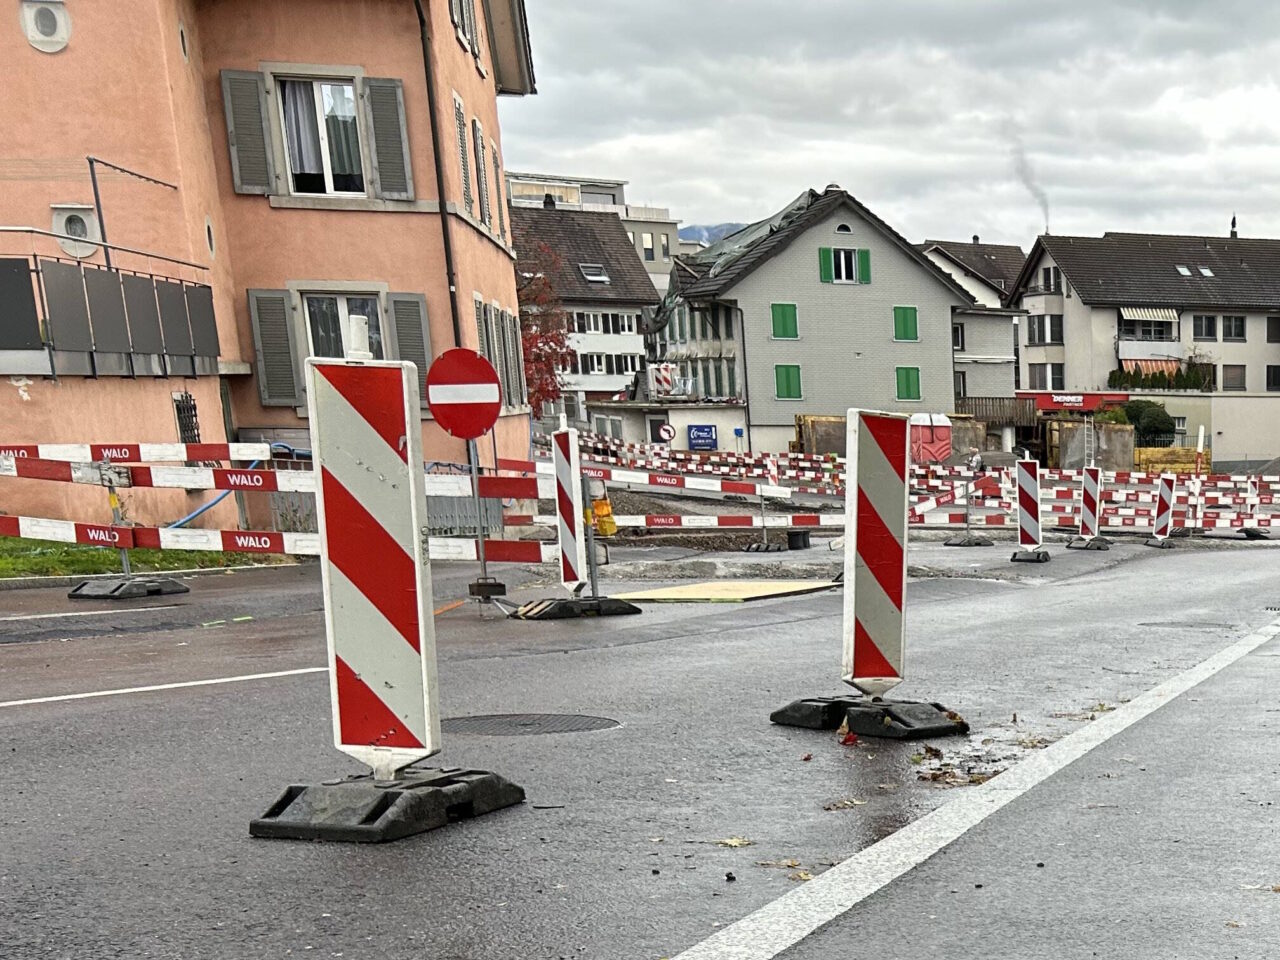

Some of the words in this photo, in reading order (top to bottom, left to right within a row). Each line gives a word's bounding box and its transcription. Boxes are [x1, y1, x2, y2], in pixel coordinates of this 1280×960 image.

[102, 448, 129, 458] WALO
[228, 473, 263, 486] WALO
[656, 476, 677, 485] WALO
[88, 528, 119, 542] WALO
[235, 535, 271, 548] WALO
